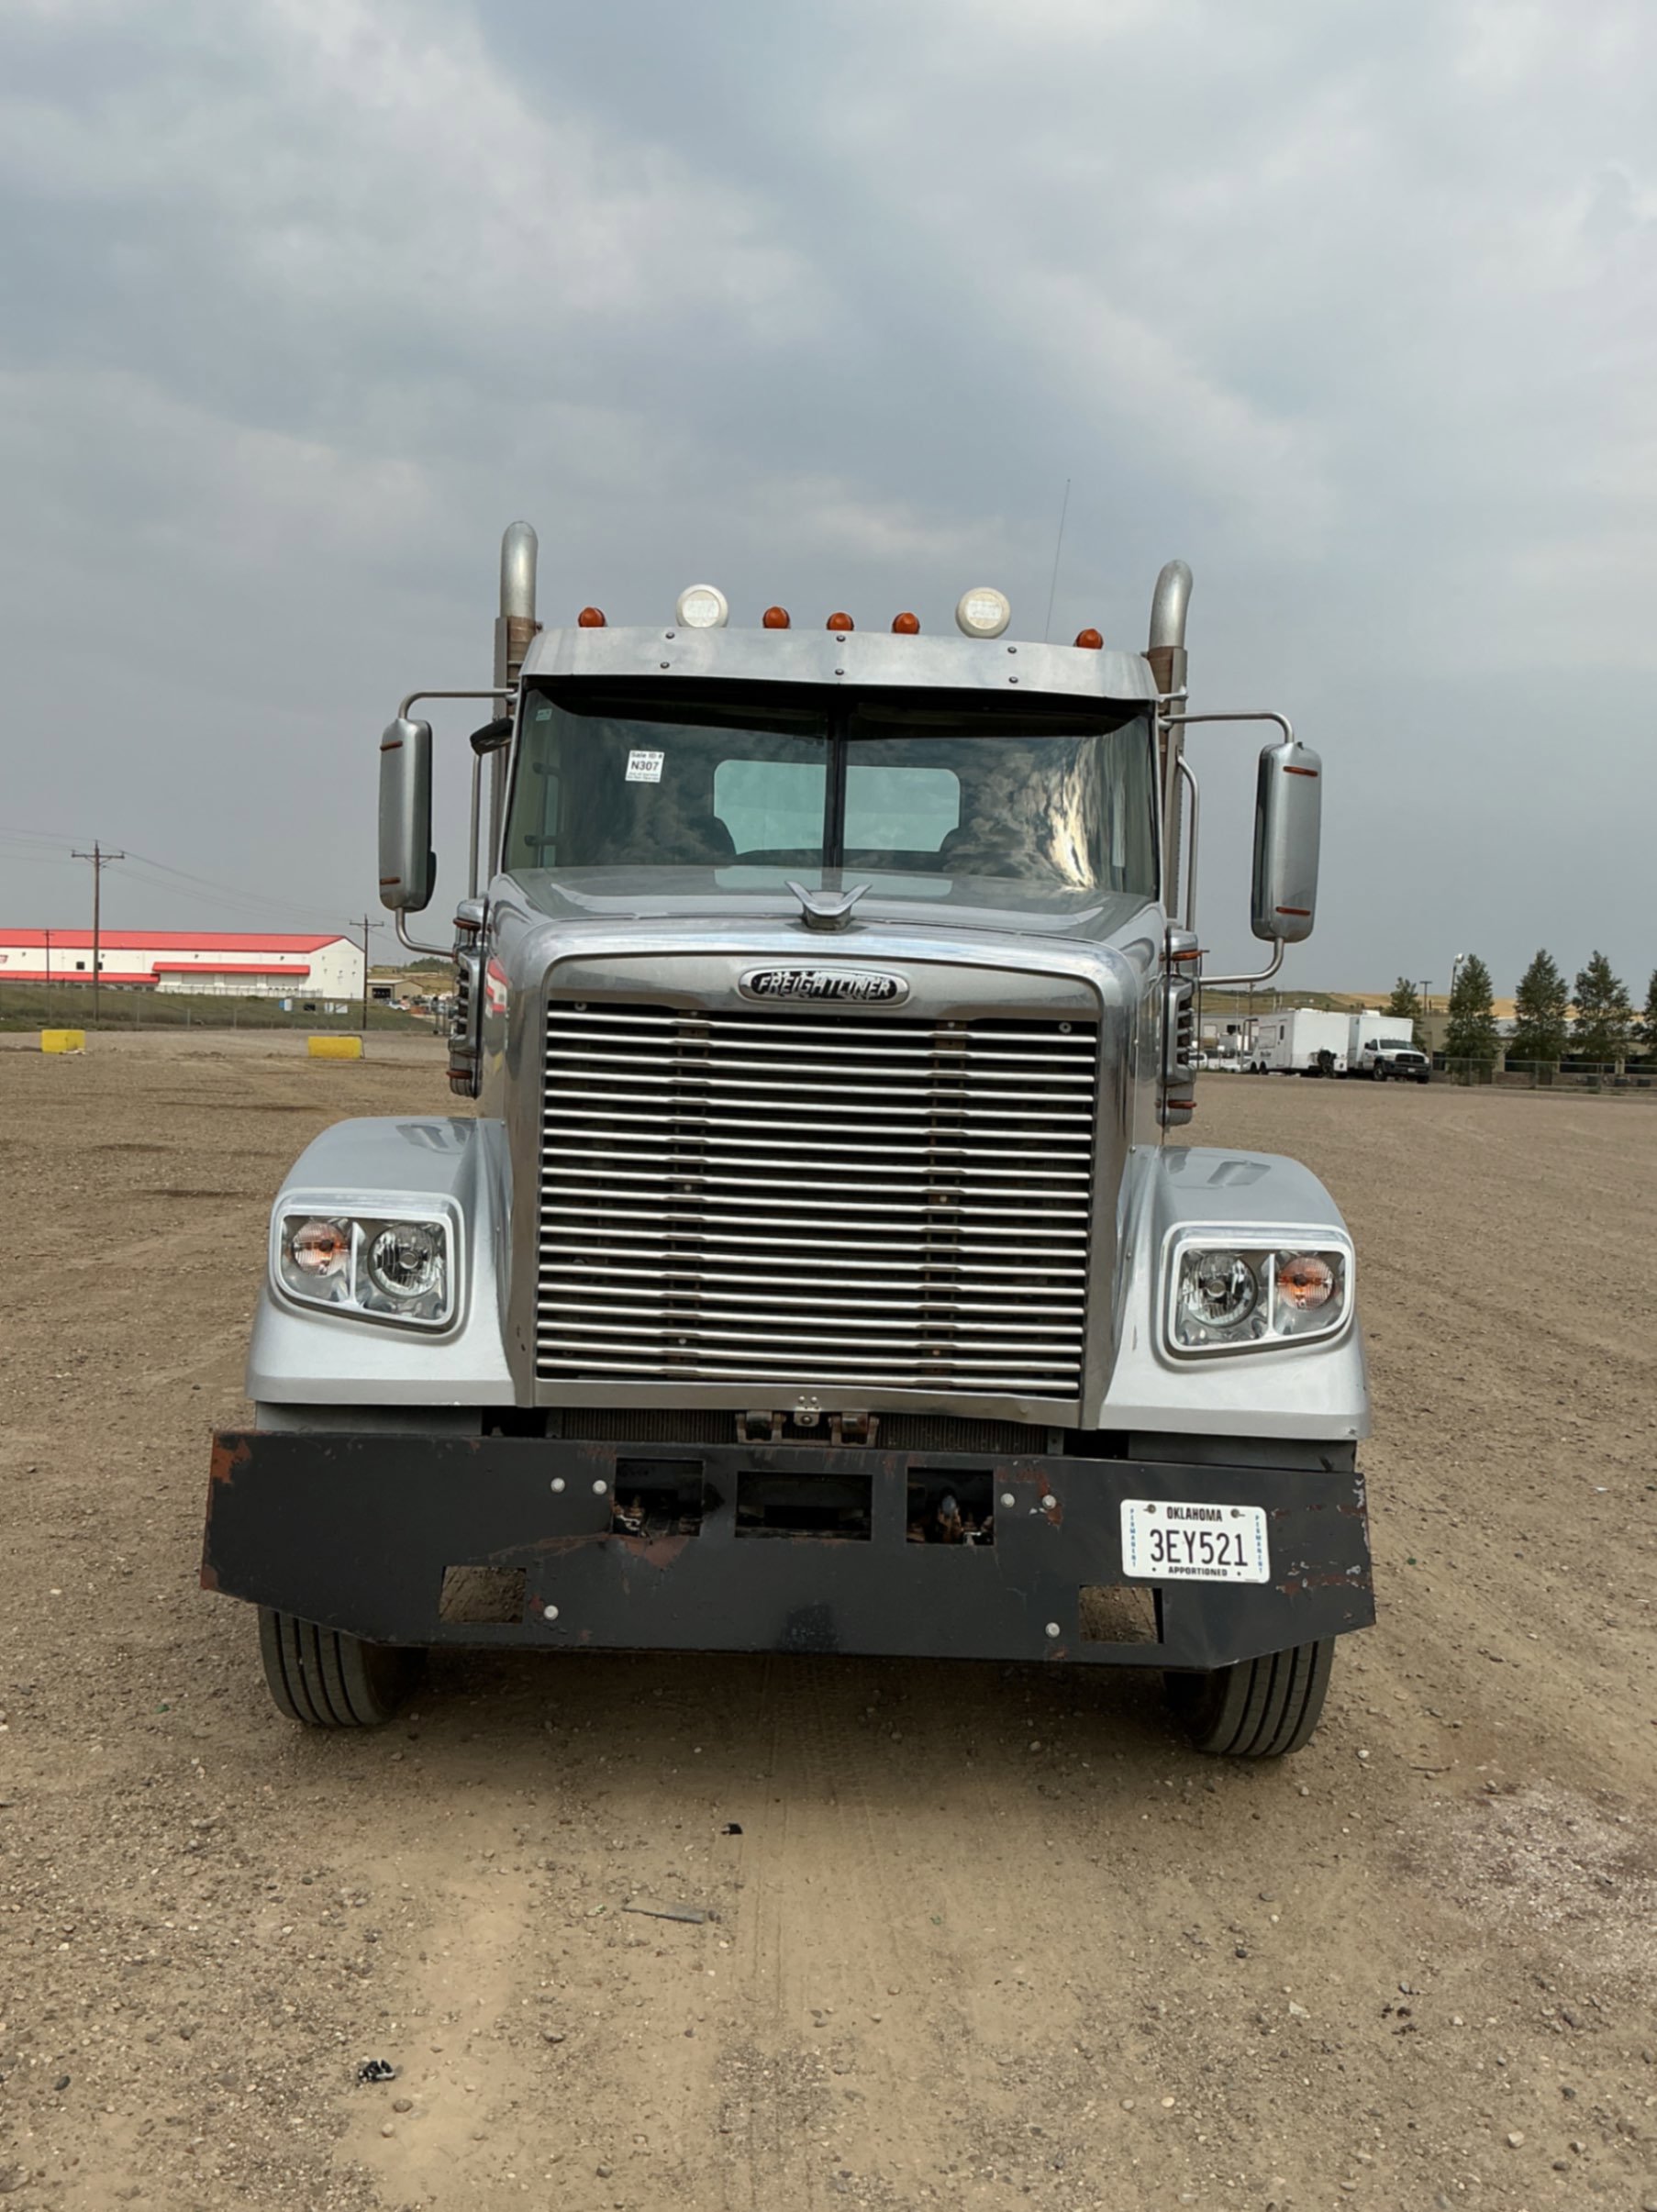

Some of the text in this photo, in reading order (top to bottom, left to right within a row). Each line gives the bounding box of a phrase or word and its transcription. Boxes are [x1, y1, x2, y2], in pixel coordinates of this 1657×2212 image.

[630, 761, 659, 771] N307
[757, 974, 890, 995] FREIGHTLINER
[1166, 1506, 1223, 1522] OKLAHOMA
[1150, 1528, 1248, 1566] 3EY521
[1168, 1566, 1228, 1576] APPORTIONED
